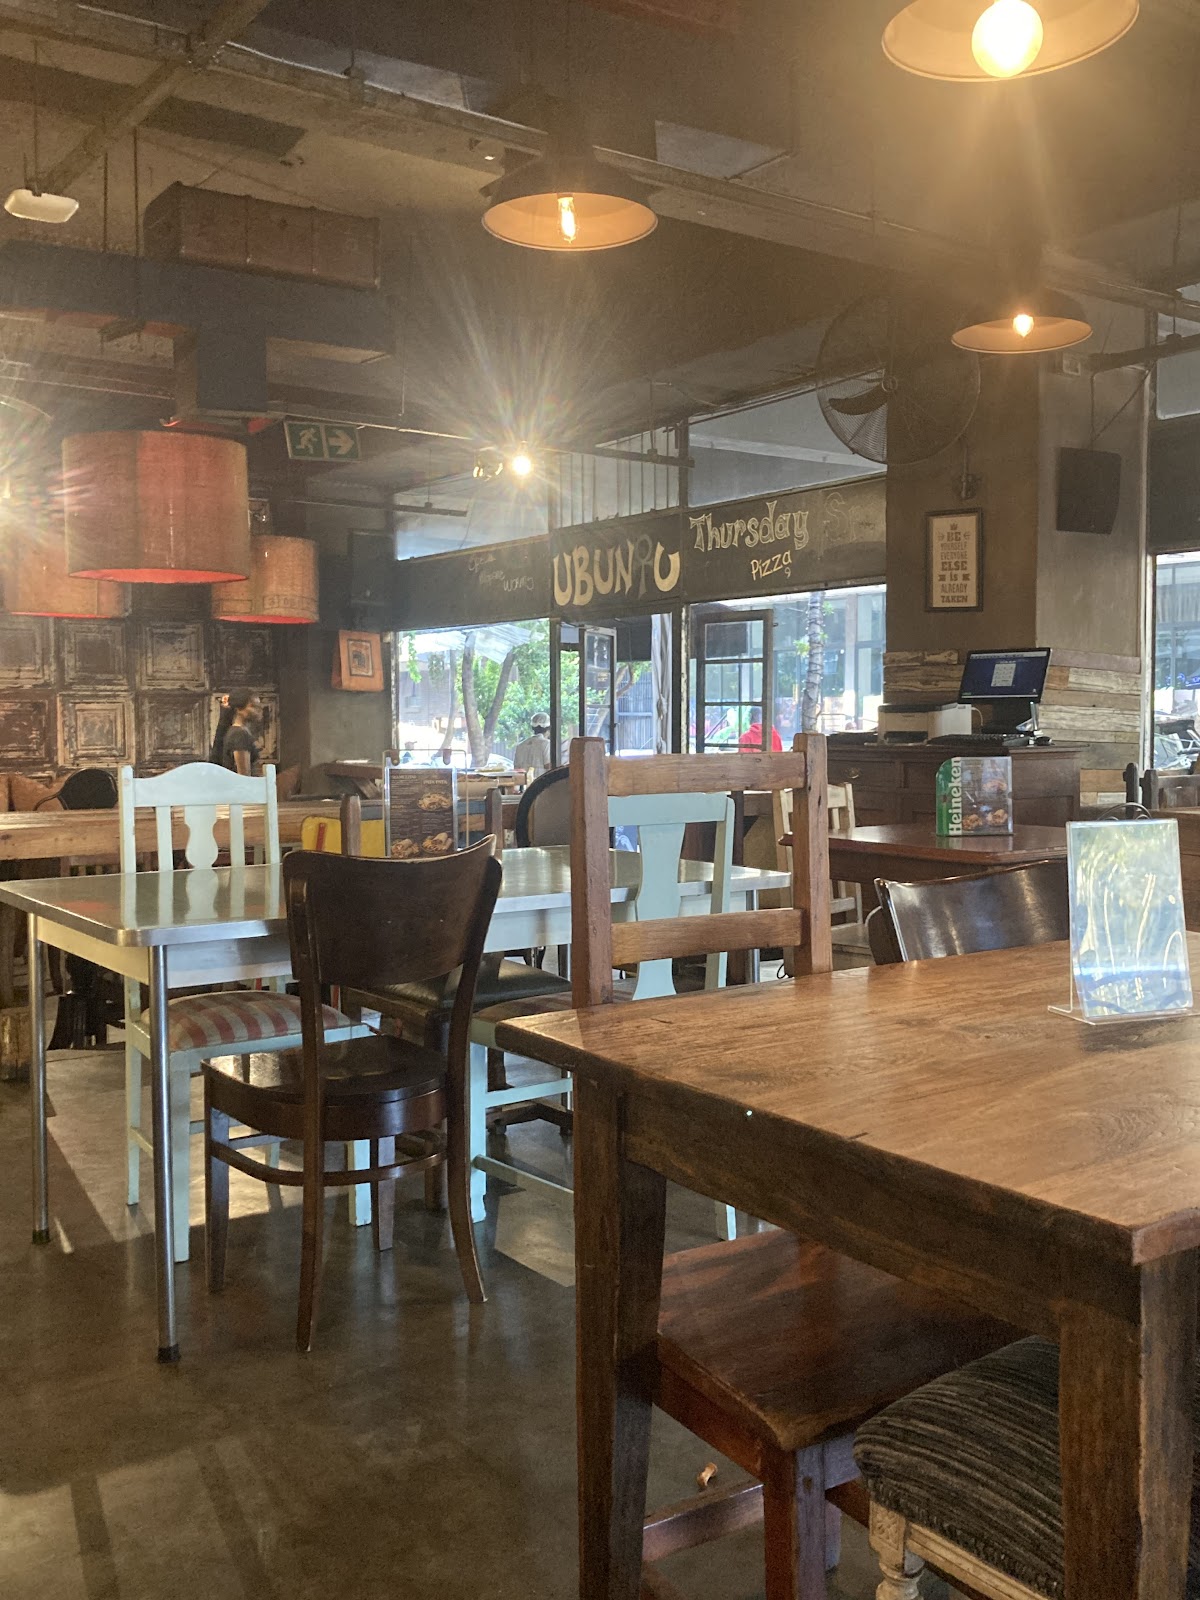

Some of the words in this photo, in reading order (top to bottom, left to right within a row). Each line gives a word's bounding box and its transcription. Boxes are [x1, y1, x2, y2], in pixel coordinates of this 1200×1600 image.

[689, 500, 810, 552] Thursday
[946, 531, 962, 542] BE
[940, 541, 968, 551] YOURSELF
[940, 551, 968, 560] EVERYONE
[750, 550, 793, 581] Pizza
[941, 560, 968, 571] ELSE
[949, 571, 959, 582] is
[940, 583, 968, 593] ALREADY
[940, 595, 968, 603] TAKEN
[948, 757, 962, 835] Heineken
